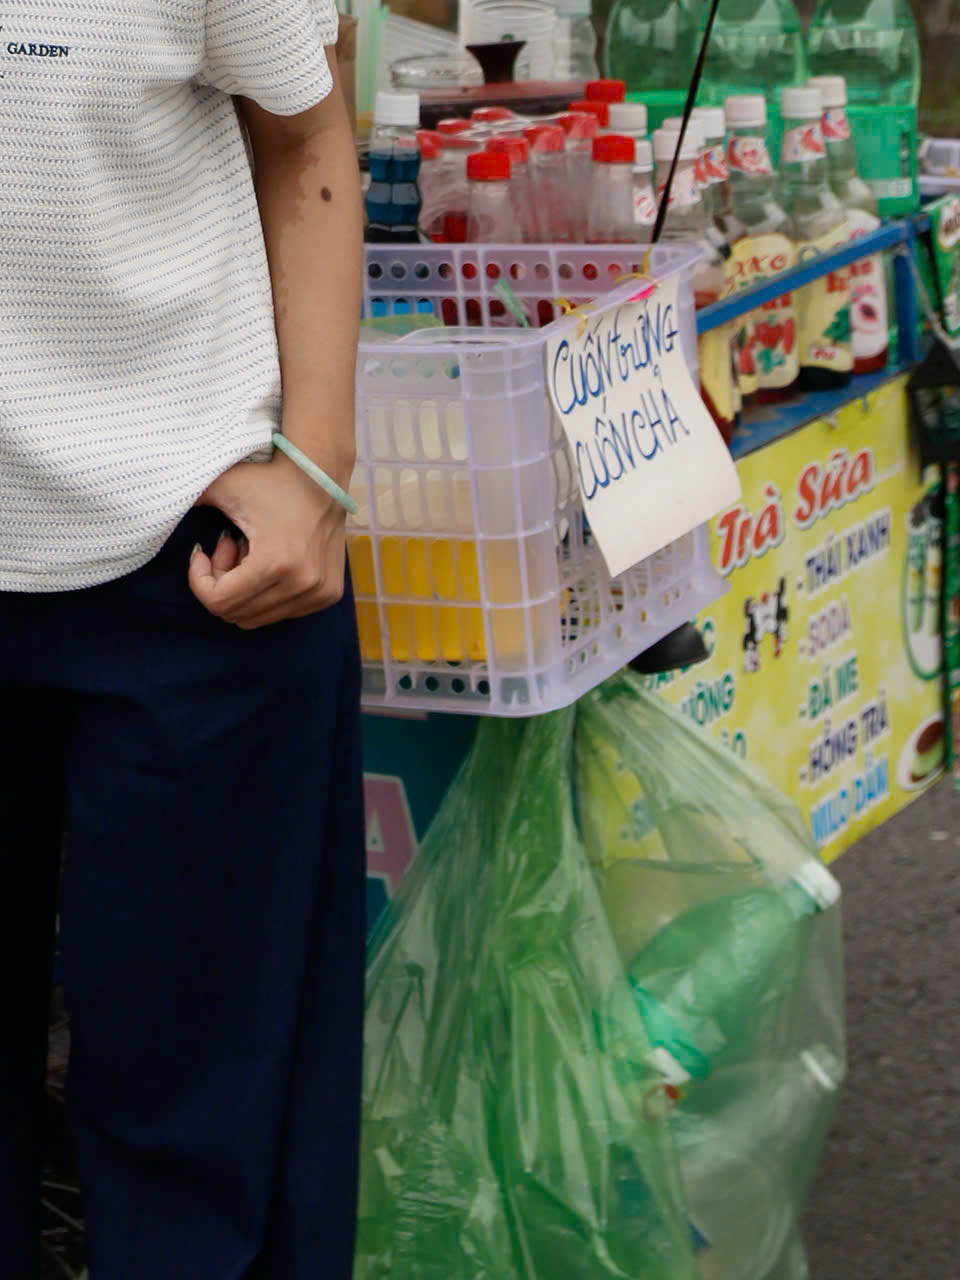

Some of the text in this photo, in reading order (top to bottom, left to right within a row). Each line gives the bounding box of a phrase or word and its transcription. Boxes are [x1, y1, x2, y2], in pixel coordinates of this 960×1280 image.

[7, 41, 70, 58] GARDEN
[717, 448, 873, 571] Trà Sữa
[845, 513, 890, 568] XANH
